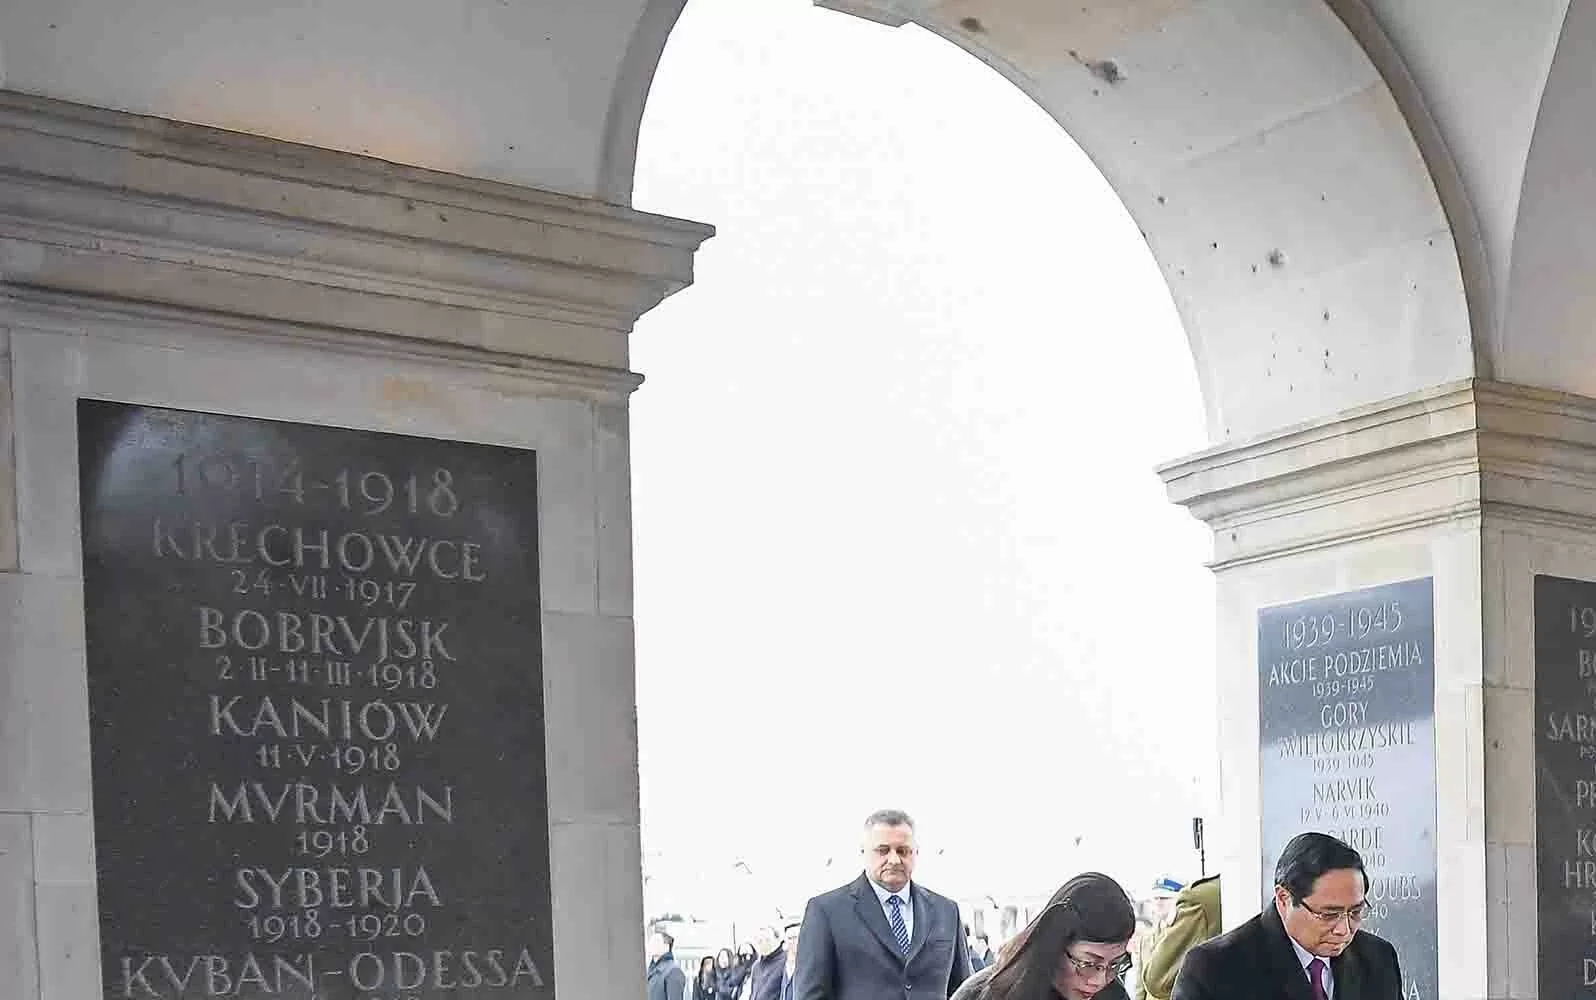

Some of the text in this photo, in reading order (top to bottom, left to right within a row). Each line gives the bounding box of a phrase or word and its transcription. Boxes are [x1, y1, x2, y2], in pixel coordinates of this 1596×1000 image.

[152, 515, 488, 583] KRECHOWCE
[1284, 602, 1403, 649] 1939-1945
[1269, 641, 1423, 687] AKCJE PODZIEMIA
[1312, 675, 1375, 697] 1939-1945
[1312, 776, 1377, 805] NARVIK
[297, 823, 370, 859] 1918
[248, 908, 427, 944] 1918-1920
